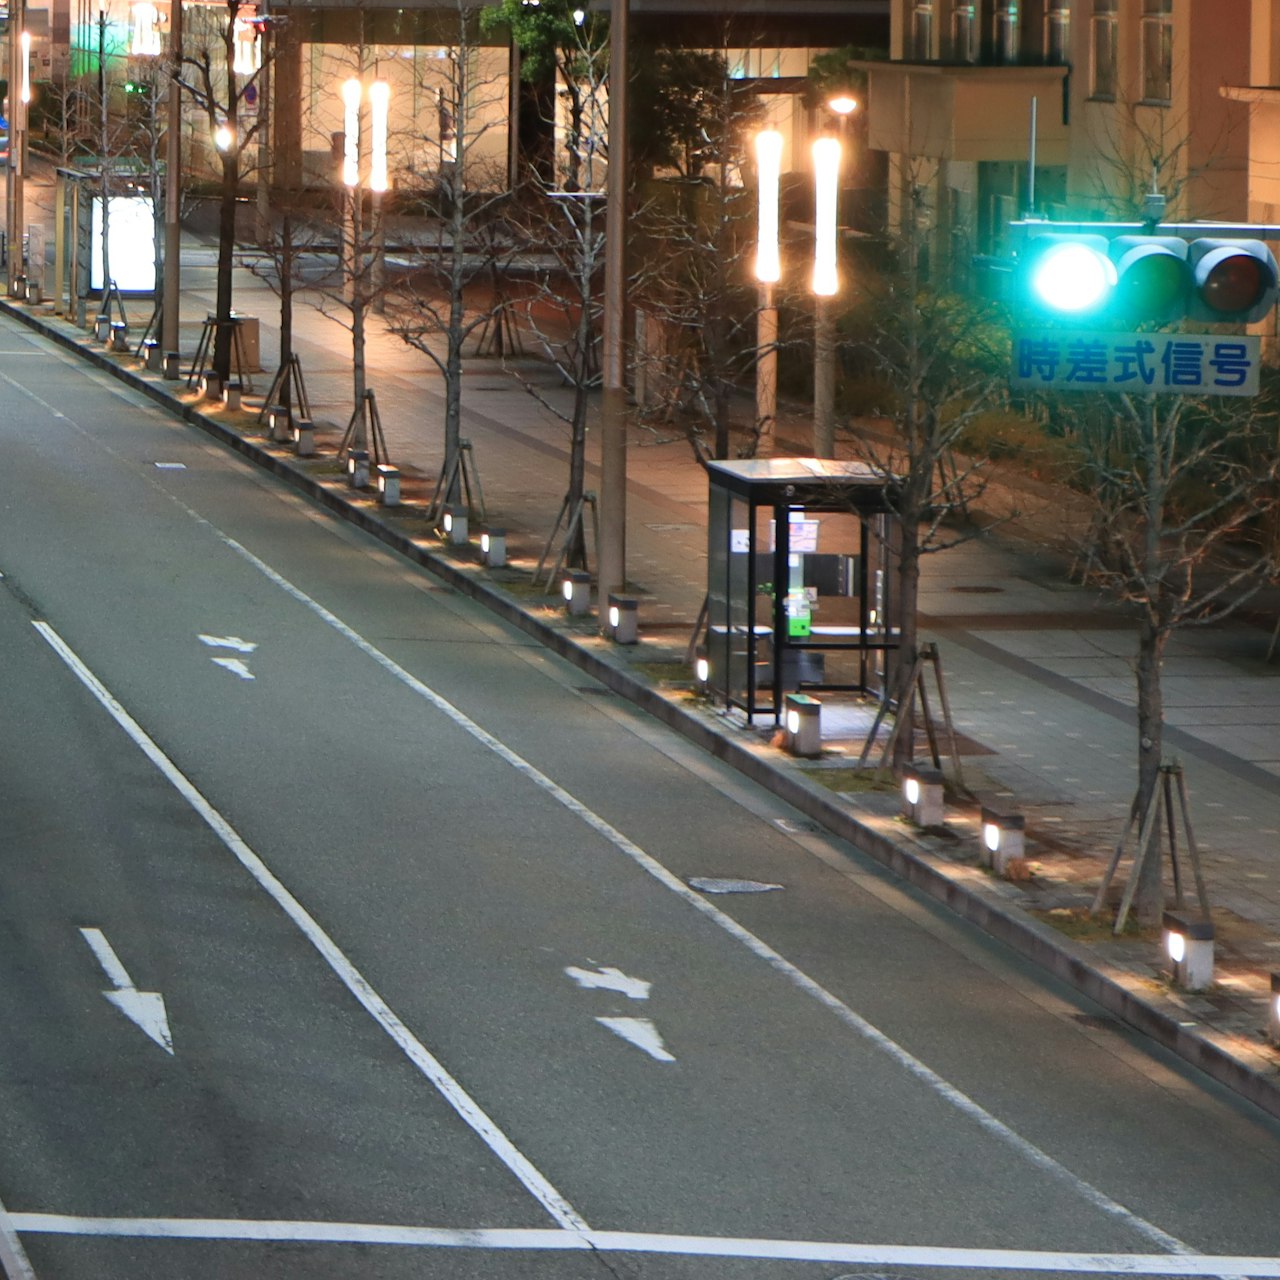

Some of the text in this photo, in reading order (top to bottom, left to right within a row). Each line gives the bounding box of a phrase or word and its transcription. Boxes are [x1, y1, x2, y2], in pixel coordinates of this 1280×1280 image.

[1018, 338, 1252, 387] 時差式信号
